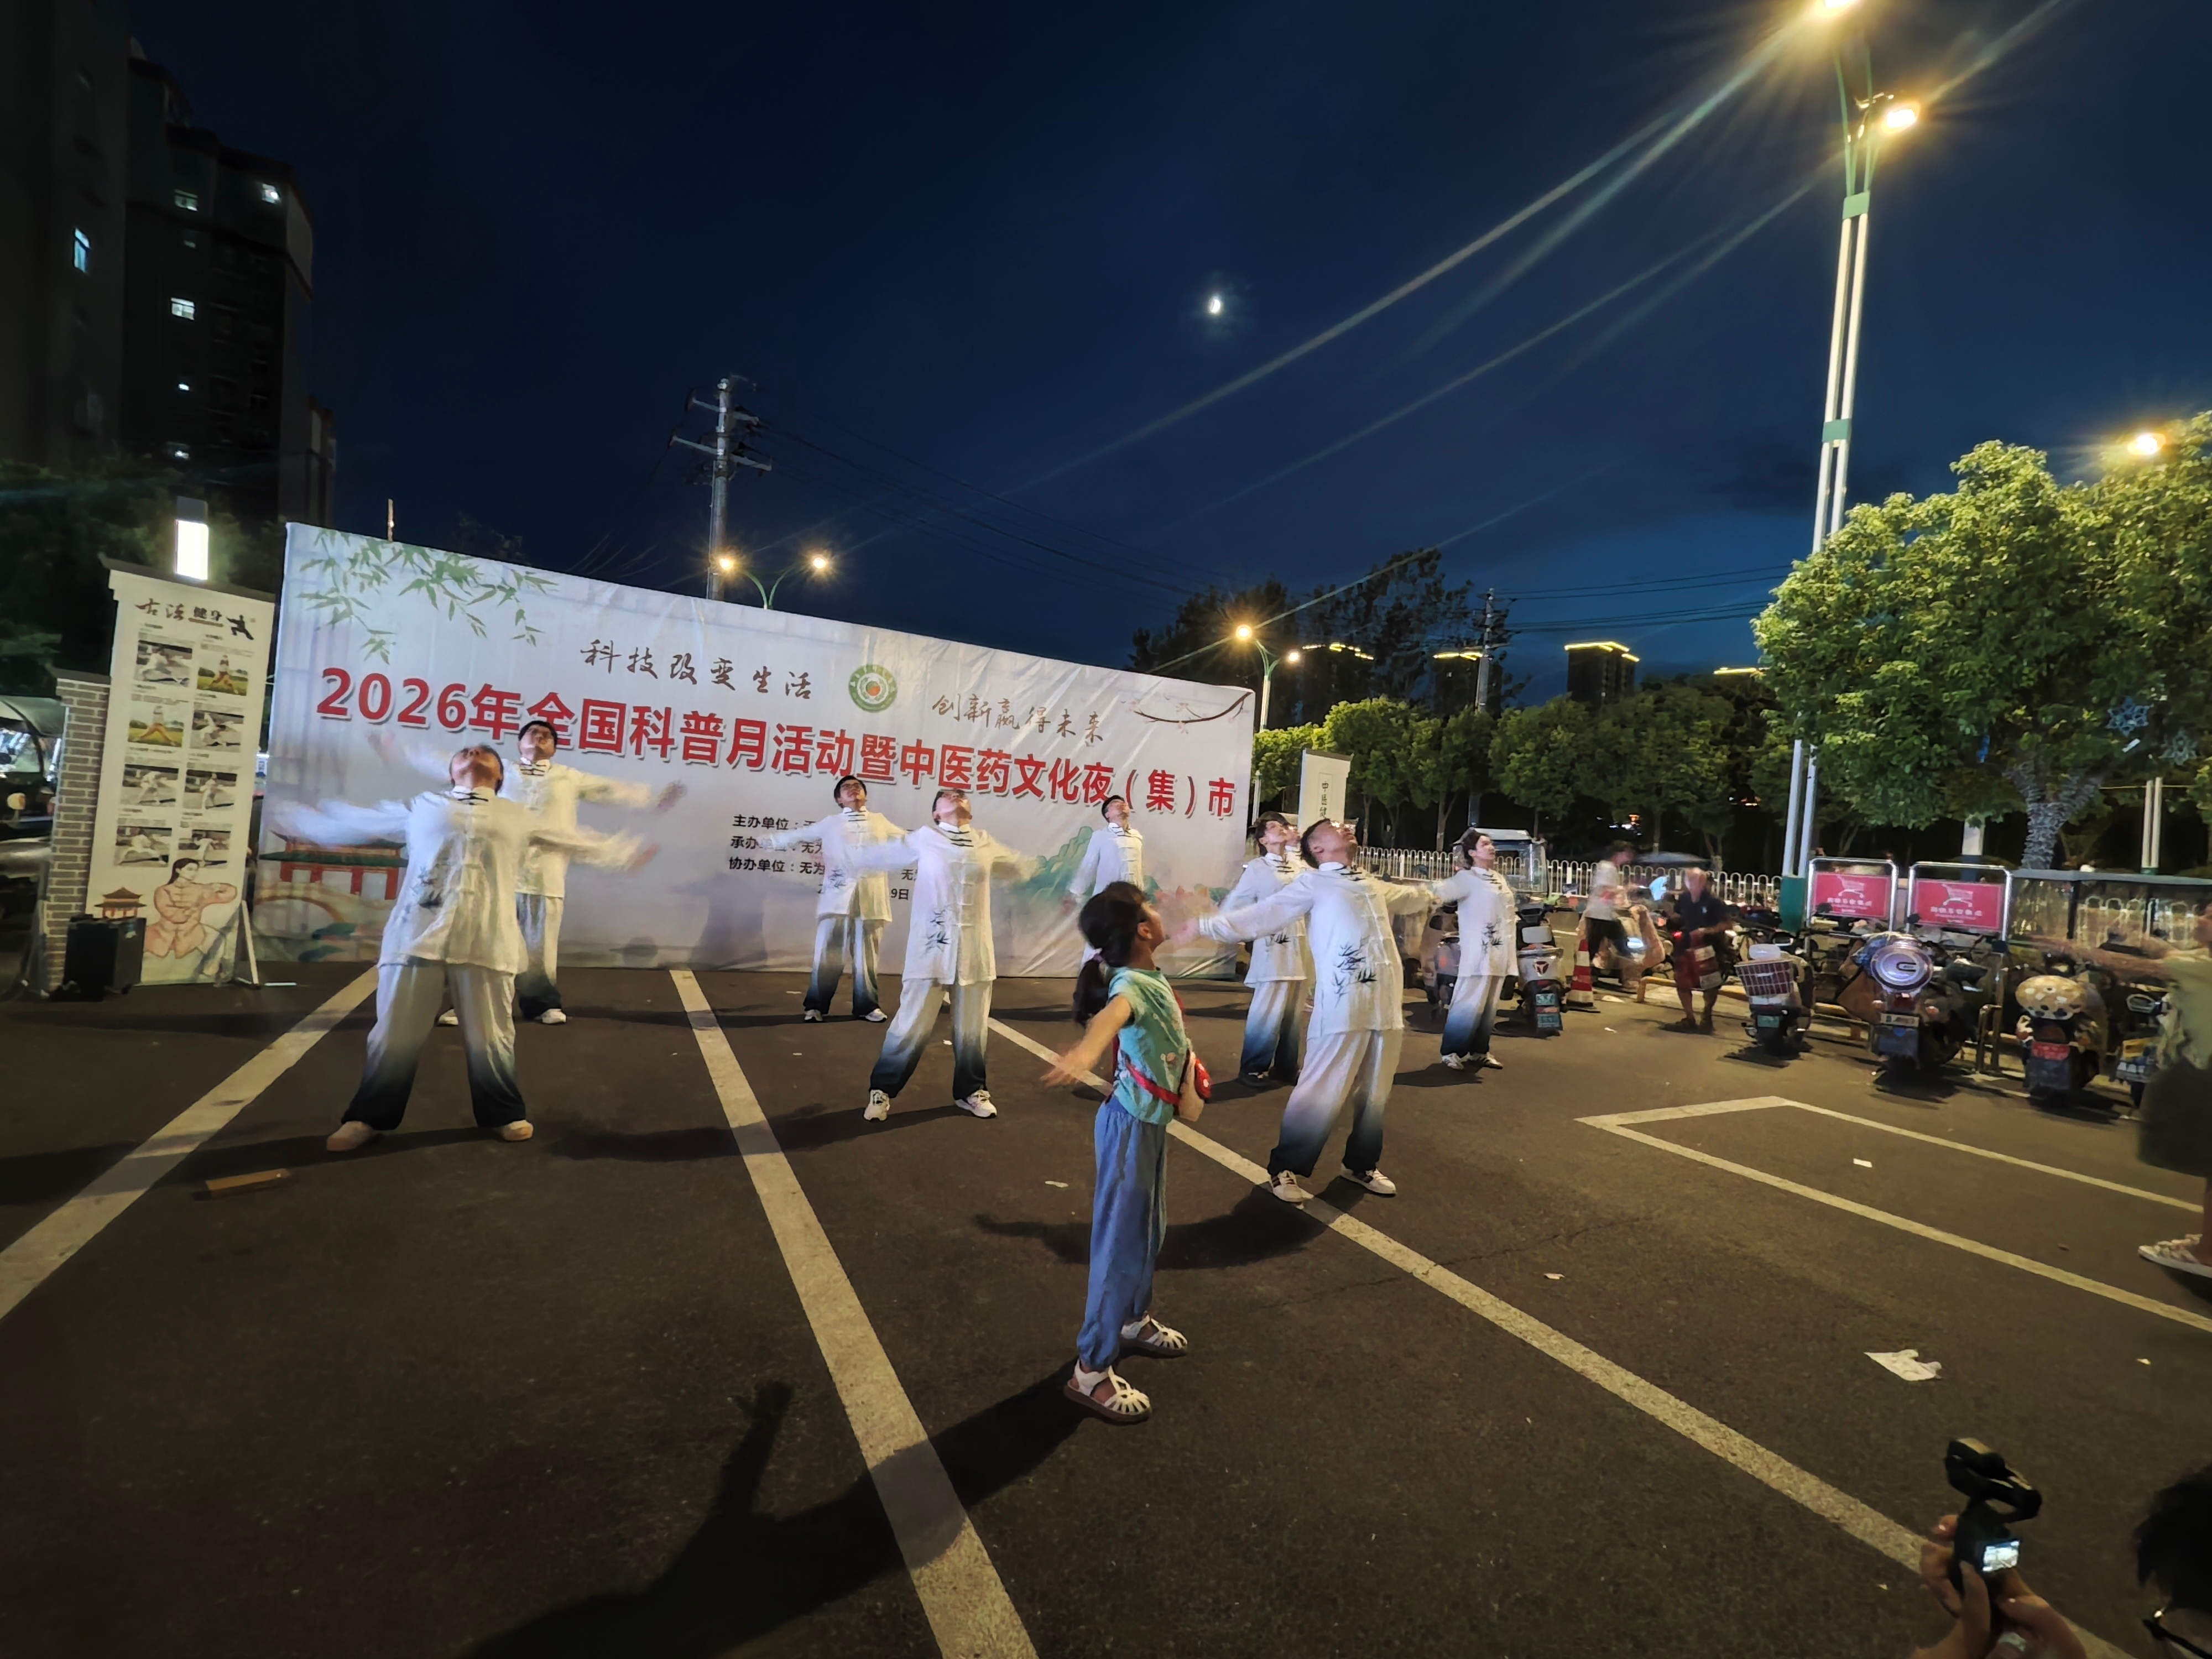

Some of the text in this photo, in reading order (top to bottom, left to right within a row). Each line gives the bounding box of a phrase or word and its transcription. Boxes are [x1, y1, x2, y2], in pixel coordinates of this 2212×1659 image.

[580, 639, 811, 699] 科技改变生活
[932, 693, 1103, 743] 创新赢得未来
